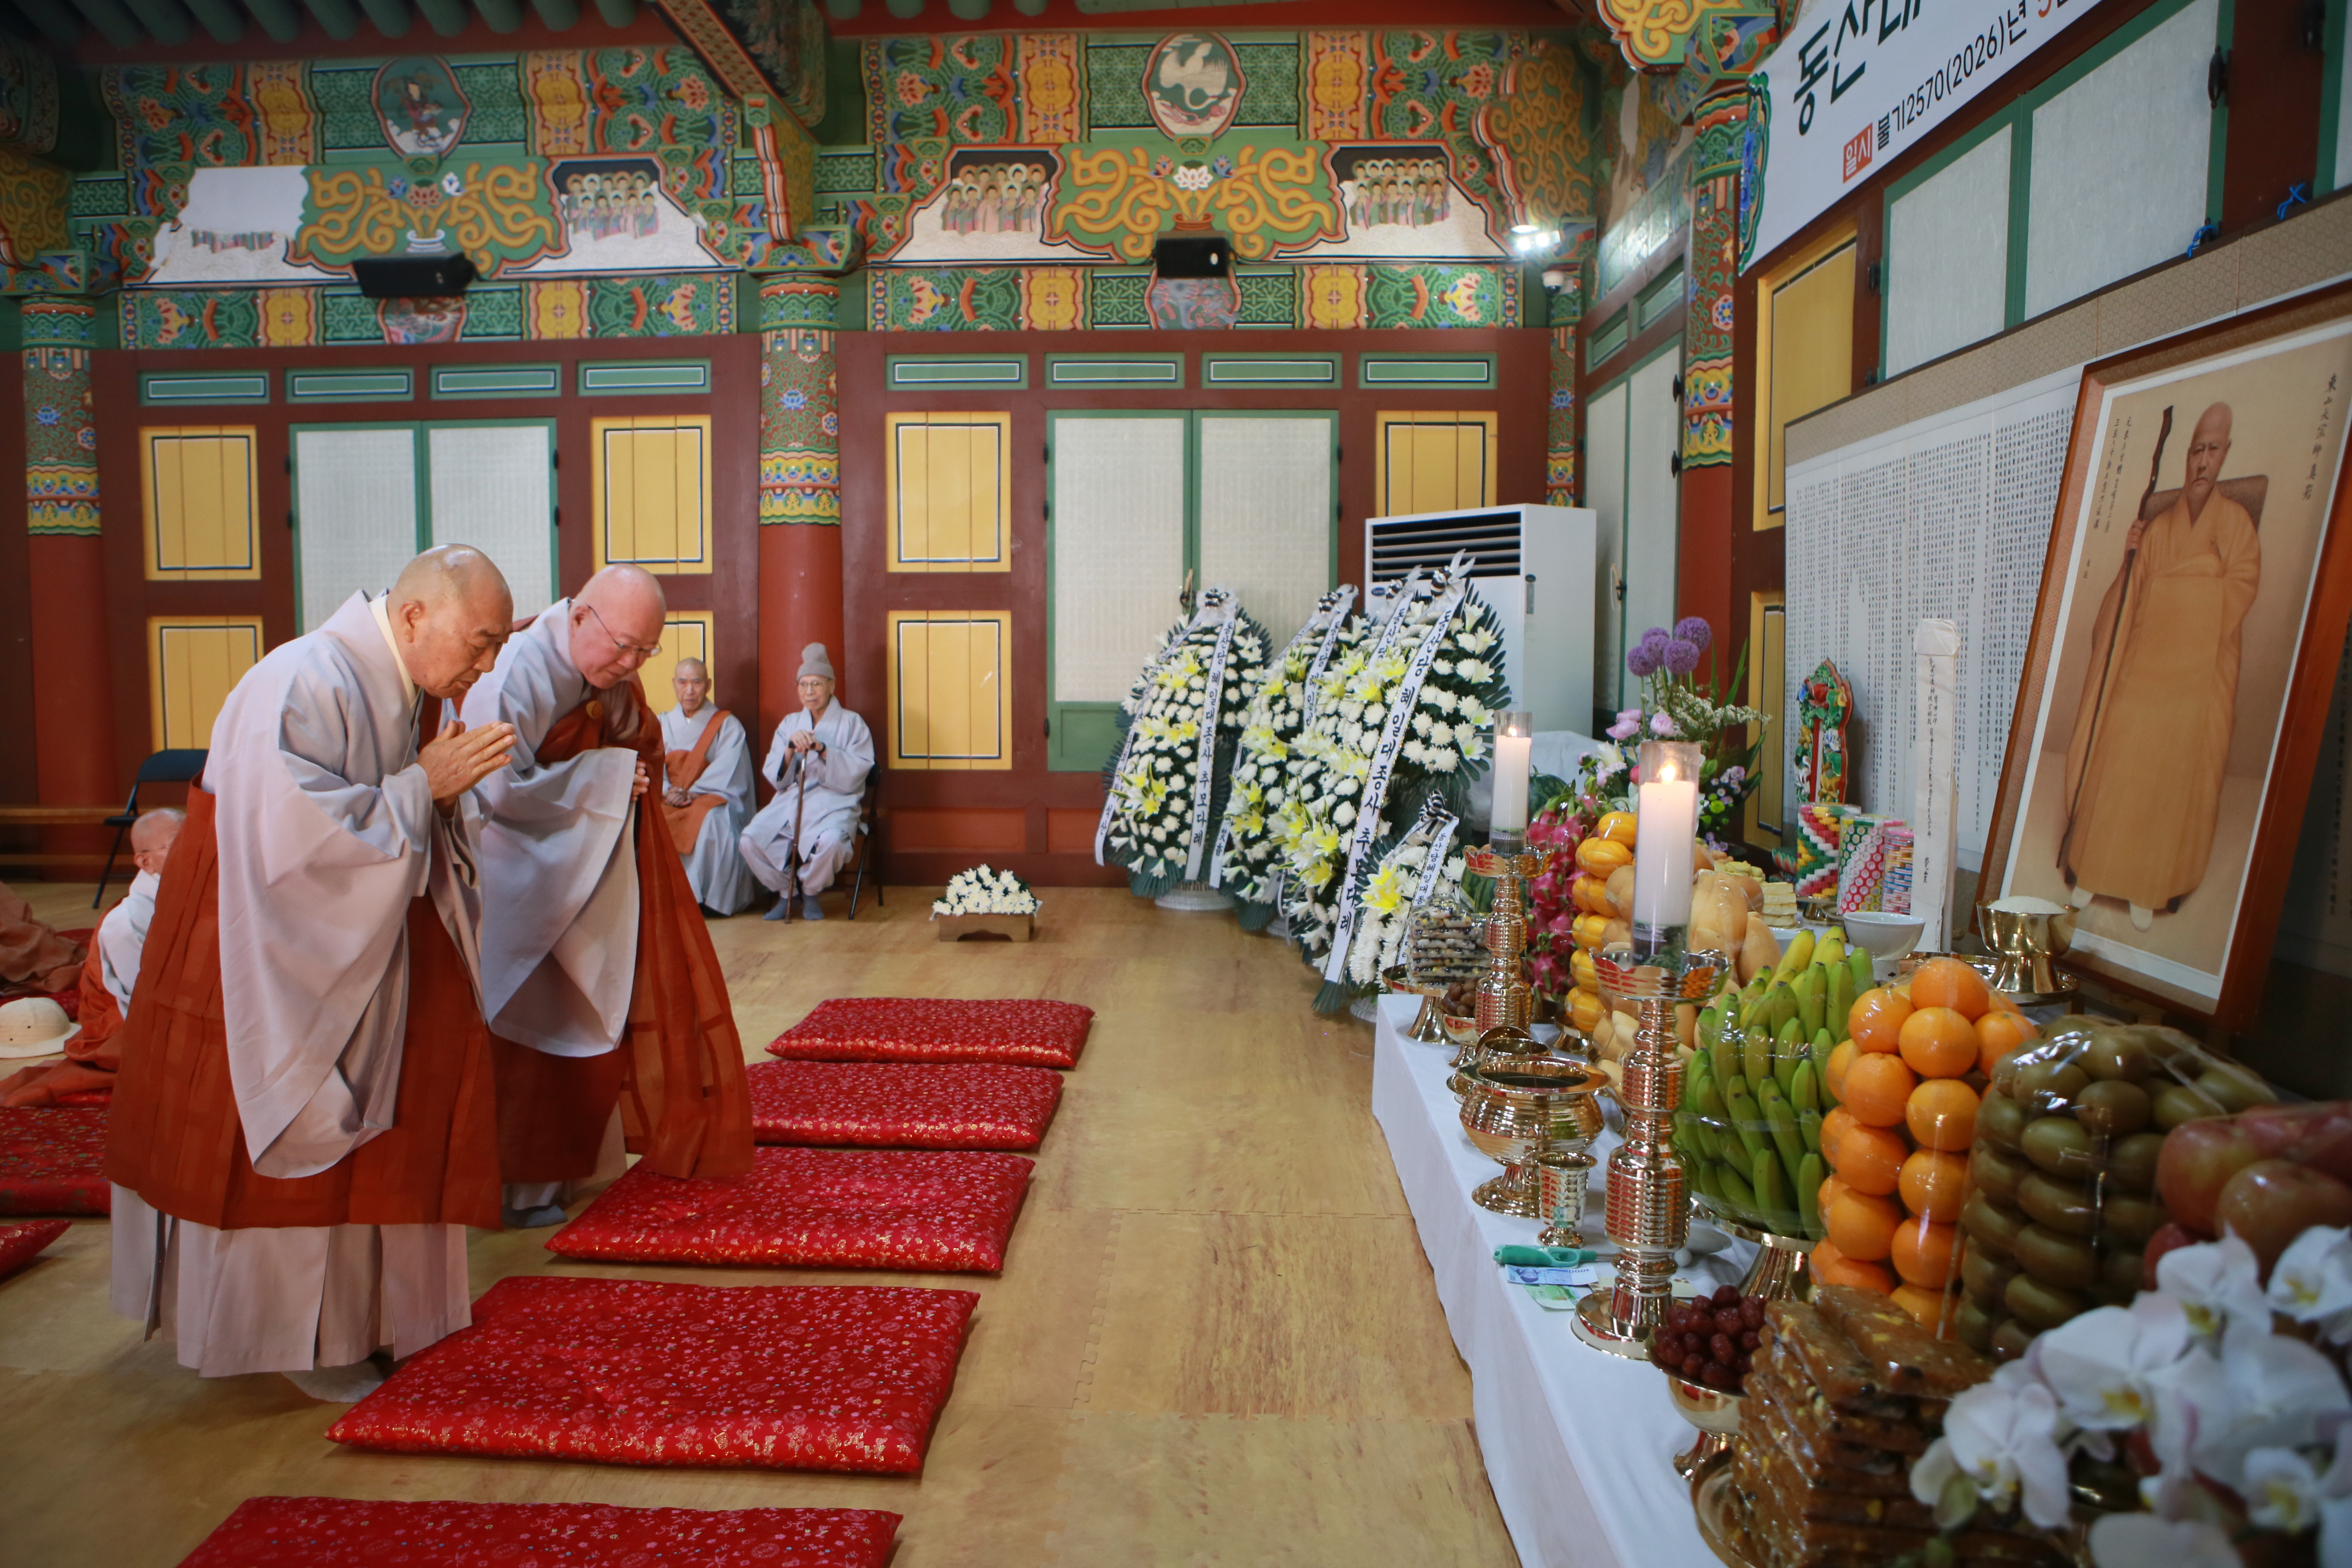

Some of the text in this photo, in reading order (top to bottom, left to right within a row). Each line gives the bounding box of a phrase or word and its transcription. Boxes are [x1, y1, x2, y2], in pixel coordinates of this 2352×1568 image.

[1846, 127, 1871, 177] 일시
[1217, 622, 1233, 665] 동산당
[1415, 609, 1452, 677] 동산당
[1364, 686, 1416, 817] 혜일대종사
[1193, 771, 1210, 847] 추모다례
